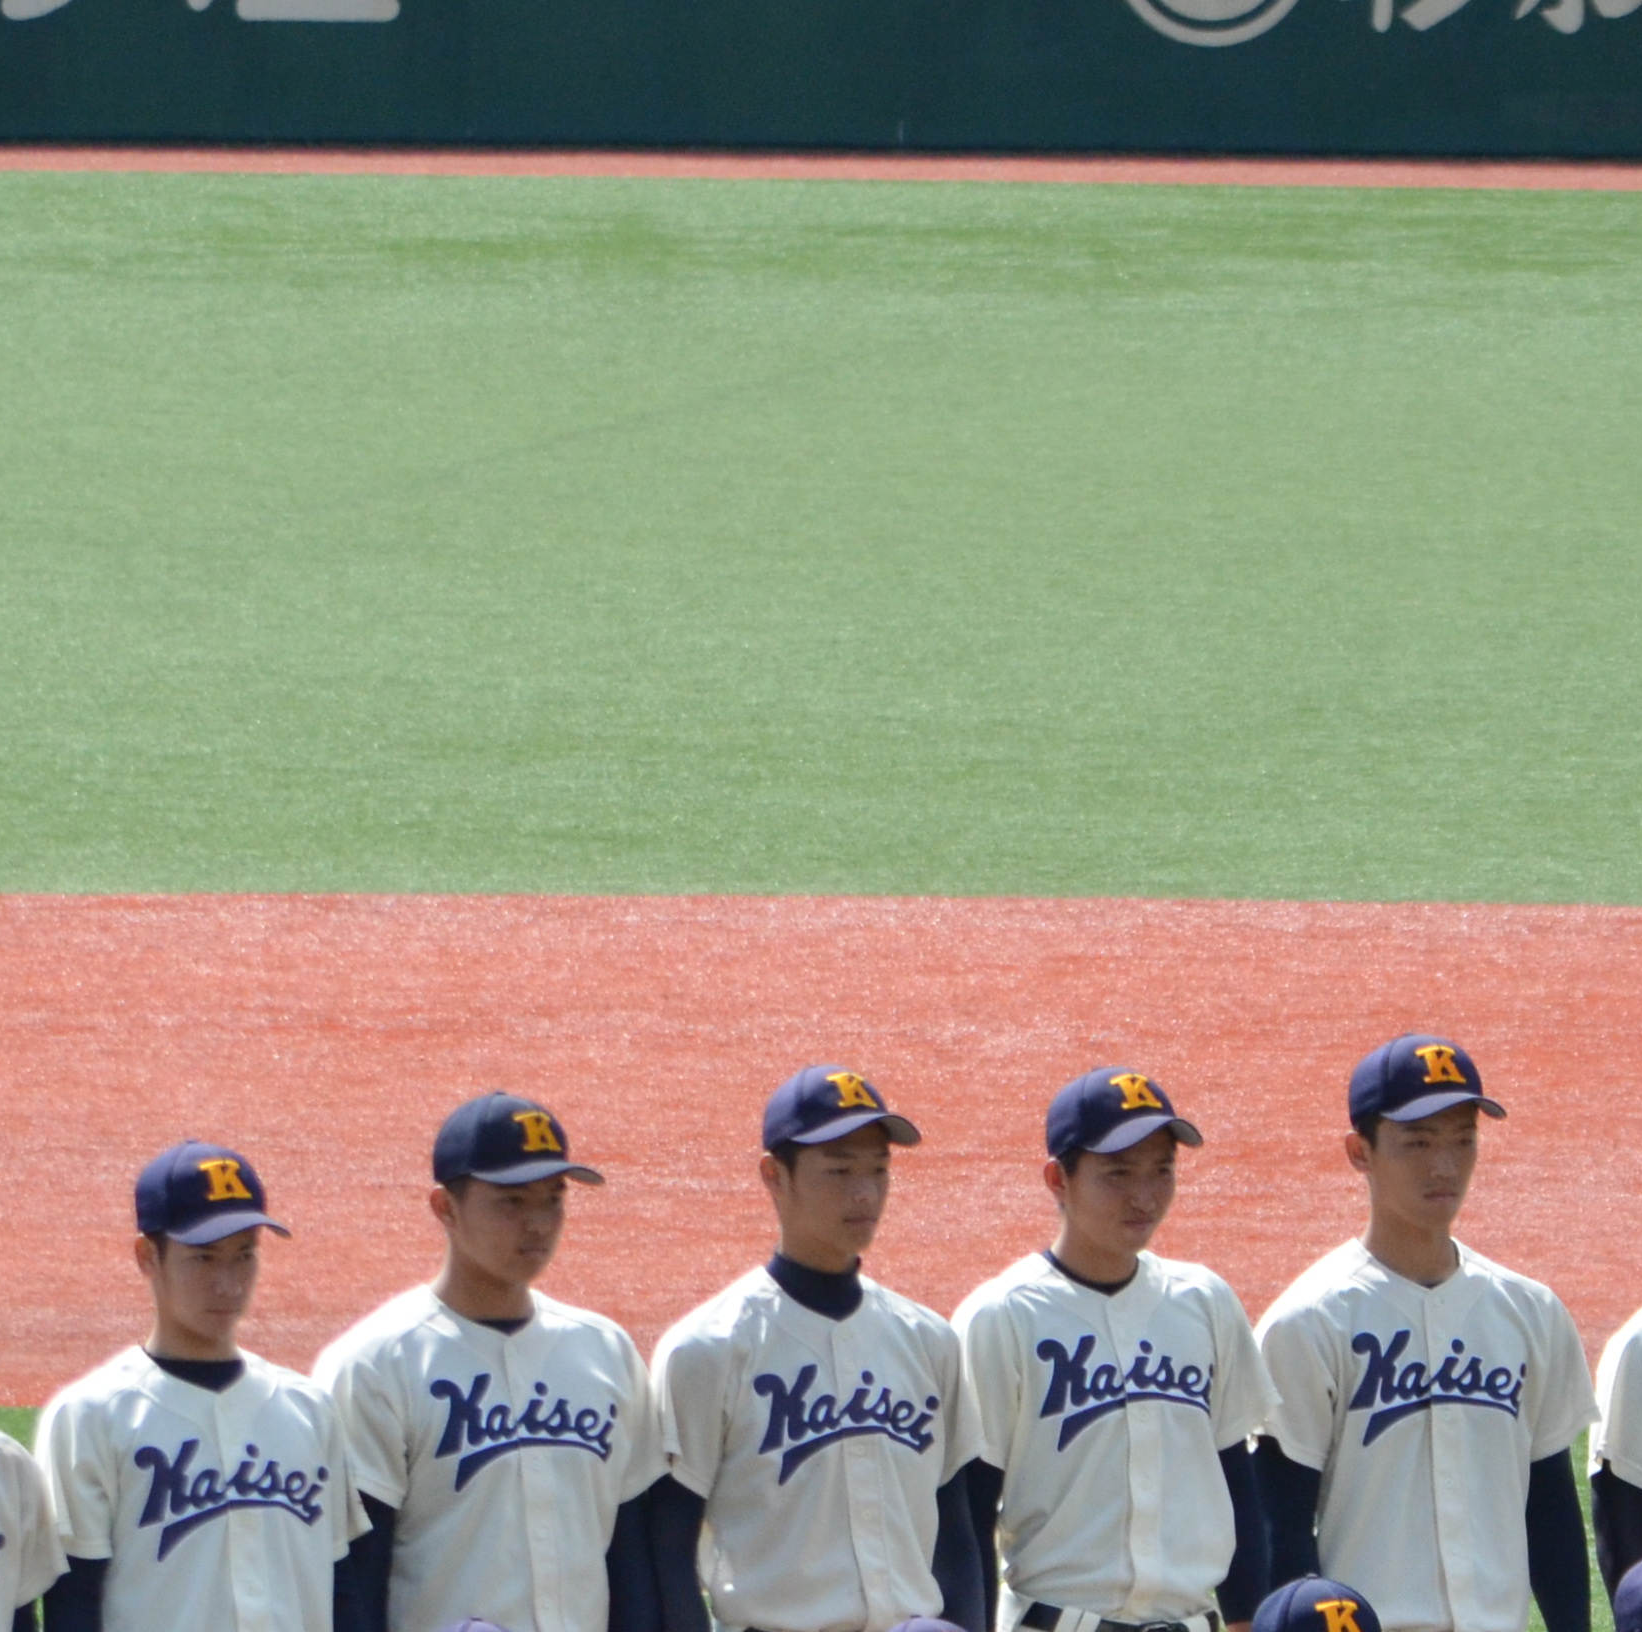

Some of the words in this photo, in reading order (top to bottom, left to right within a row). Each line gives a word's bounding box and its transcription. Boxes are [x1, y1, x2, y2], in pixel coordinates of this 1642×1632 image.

[1415, 1044, 1467, 1085] K
[826, 1072, 877, 1109] K
[1108, 1073, 1163, 1110] K
[514, 1111, 563, 1152] K
[199, 1158, 253, 1202] K
[1349, 1330, 1526, 1446] Kaisei
[429, 1373, 616, 1491] Kaisei
[753, 1363, 940, 1485] Kaisei
[133, 1439, 328, 1561] Kaisei
